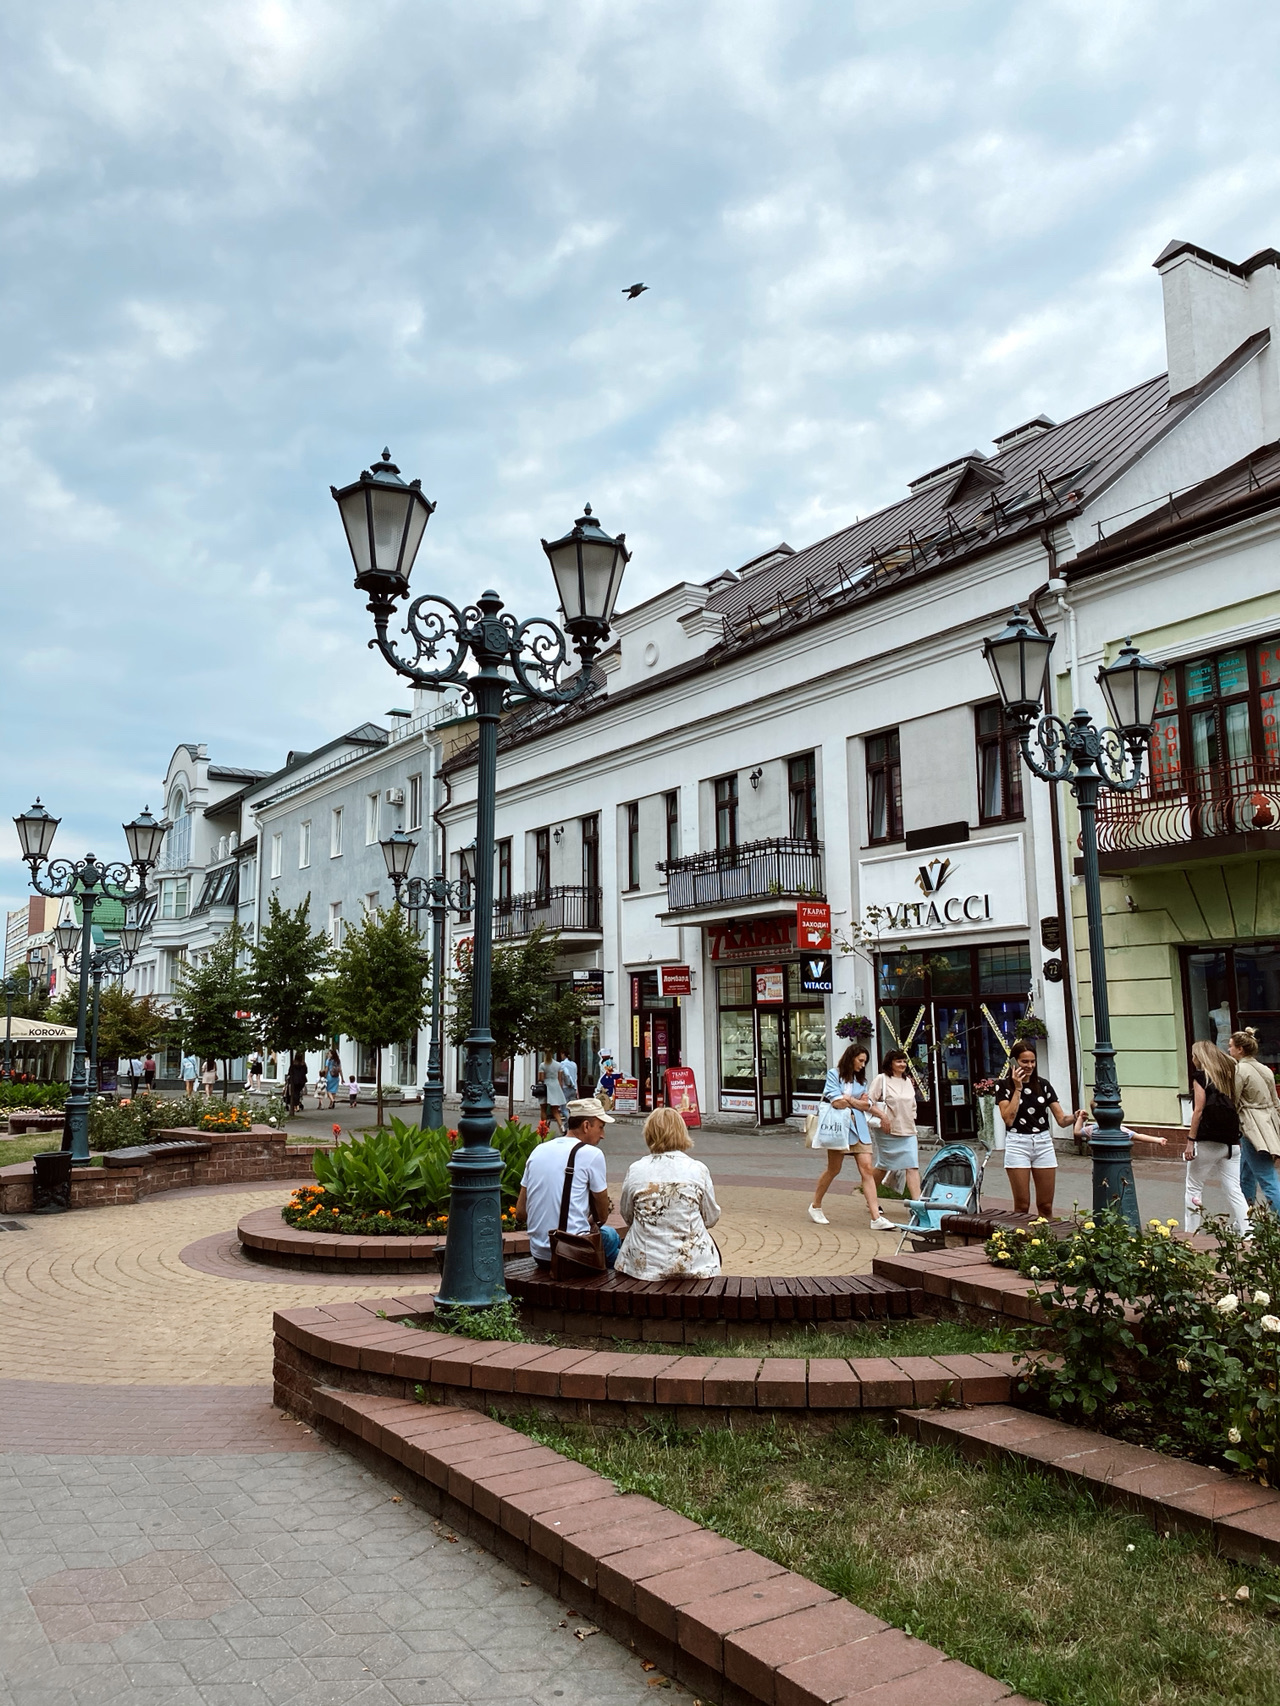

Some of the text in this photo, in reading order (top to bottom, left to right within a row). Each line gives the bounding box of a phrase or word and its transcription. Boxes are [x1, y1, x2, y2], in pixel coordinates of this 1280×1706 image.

[802, 907, 828, 916] 7КАРАТ
[886, 893, 992, 929] VITACCI
[801, 921, 829, 929] ЗАХОДИ!
[1049, 965, 1058, 974] 72
[803, 981, 832, 990] VITACCI
[28, 1028, 67, 1036] KOROVA
[821, 1122, 842, 1133] oodji
